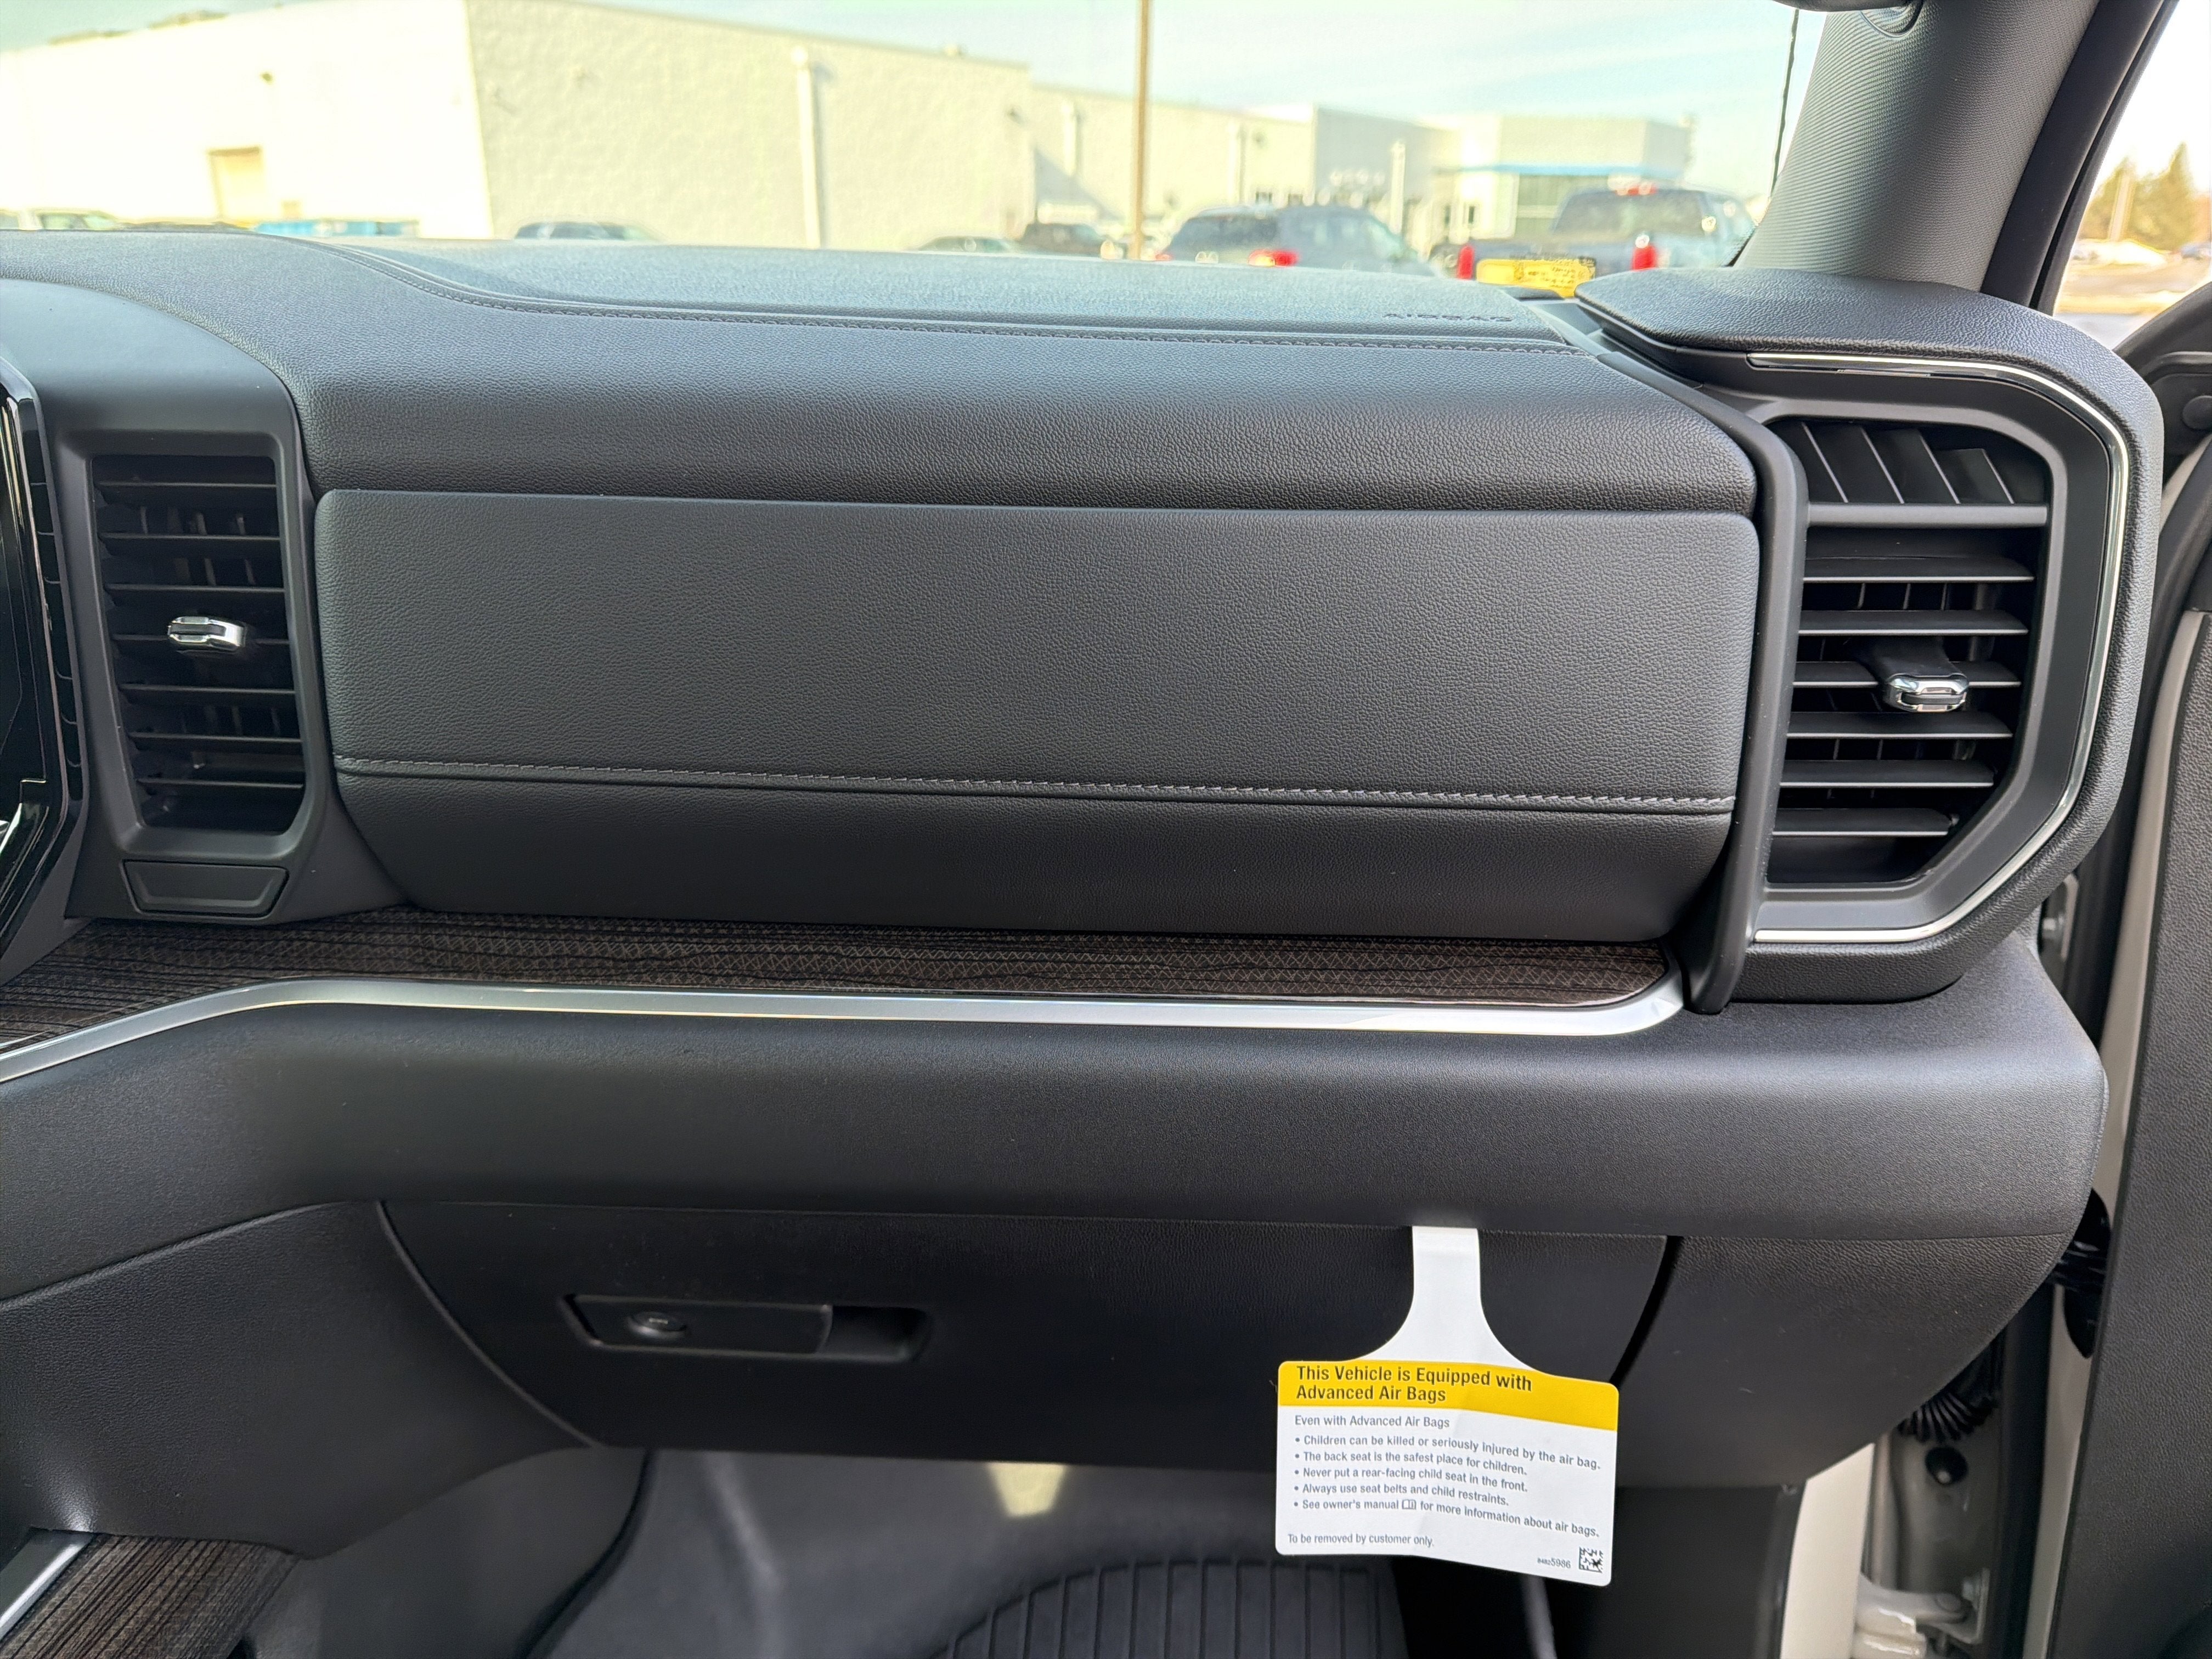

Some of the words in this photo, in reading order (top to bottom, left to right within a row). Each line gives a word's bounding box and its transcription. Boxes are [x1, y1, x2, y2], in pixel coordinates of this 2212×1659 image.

[1297, 1365, 1329, 1380] This
[1335, 1365, 1391, 1380] Vehicle
[1398, 1367, 1410, 1381] is
[1417, 1368, 1490, 1386] Equipped
[1496, 1374, 1531, 1391] with
[1296, 1385, 1373, 1400] Advanced
[1379, 1385, 1401, 1400] Air
[1407, 1386, 1446, 1404] Bags
[1295, 1415, 1319, 1425] Even
[1324, 1415, 1346, 1425] with
[1350, 1415, 1401, 1426] Advanced
[1405, 1416, 1420, 1426] Air
[1424, 1417, 1449, 1430] Bags
[1304, 1435, 1346, 1444] Children
[1372, 1436, 1383, 1444] be
[1387, 1436, 1414, 1446] killed
[1432, 1437, 1479, 1452] seriously
[1483, 1442, 1519, 1457] injured
[1523, 1448, 1535, 1461] by
[1539, 1451, 1555, 1462] the
[1560, 1454, 1574, 1465] air
[1577, 1456, 1600, 1470] bag.
[1304, 1452, 1321, 1461] The
[1324, 1452, 1347, 1461] back
[1351, 1452, 1371, 1461] seat
[1374, 1452, 1382, 1461] is
[1386, 1452, 1400, 1461] the
[1404, 1453, 1433, 1463] safest
[1437, 1454, 1463, 1465] place
[1466, 1457, 1480, 1468] for
[1483, 1459, 1527, 1475] children.
[1304, 1468, 1331, 1477] Never
[1335, 1468, 1350, 1479] put
[1362, 1468, 1415, 1480] rear-facing
[1419, 1469, 1442, 1479] child
[1446, 1472, 1466, 1482] seat
[1470, 1473, 1478, 1485] in
[1482, 1476, 1497, 1487] the
[1501, 1479, 1527, 1492] front.
[1302, 1484, 1336, 1495] Always
[1361, 1484, 1380, 1493] seat
[1384, 1484, 1407, 1493] belts
[1410, 1485, 1428, 1494] and
[1432, 1486, 1455, 1497] child
[1459, 1491, 1508, 1507] restraints.
[1303, 1499, 1319, 1509] See
[1323, 1500, 1361, 1509] owner's
[1364, 1500, 1398, 1509] manual
[1420, 1501, 1434, 1511] for
[1437, 1504, 1461, 1515] more
[1465, 1506, 1520, 1525] information
[1524, 1516, 1552, 1530] about
[1555, 1521, 1568, 1531] air
[1572, 1523, 1599, 1537] bags.
[1288, 1534, 1297, 1543] To
[1301, 1534, 1311, 1543] be
[1314, 1534, 1352, 1543] removed
[1356, 1534, 1366, 1544] by
[1369, 1534, 1411, 1543] customer
